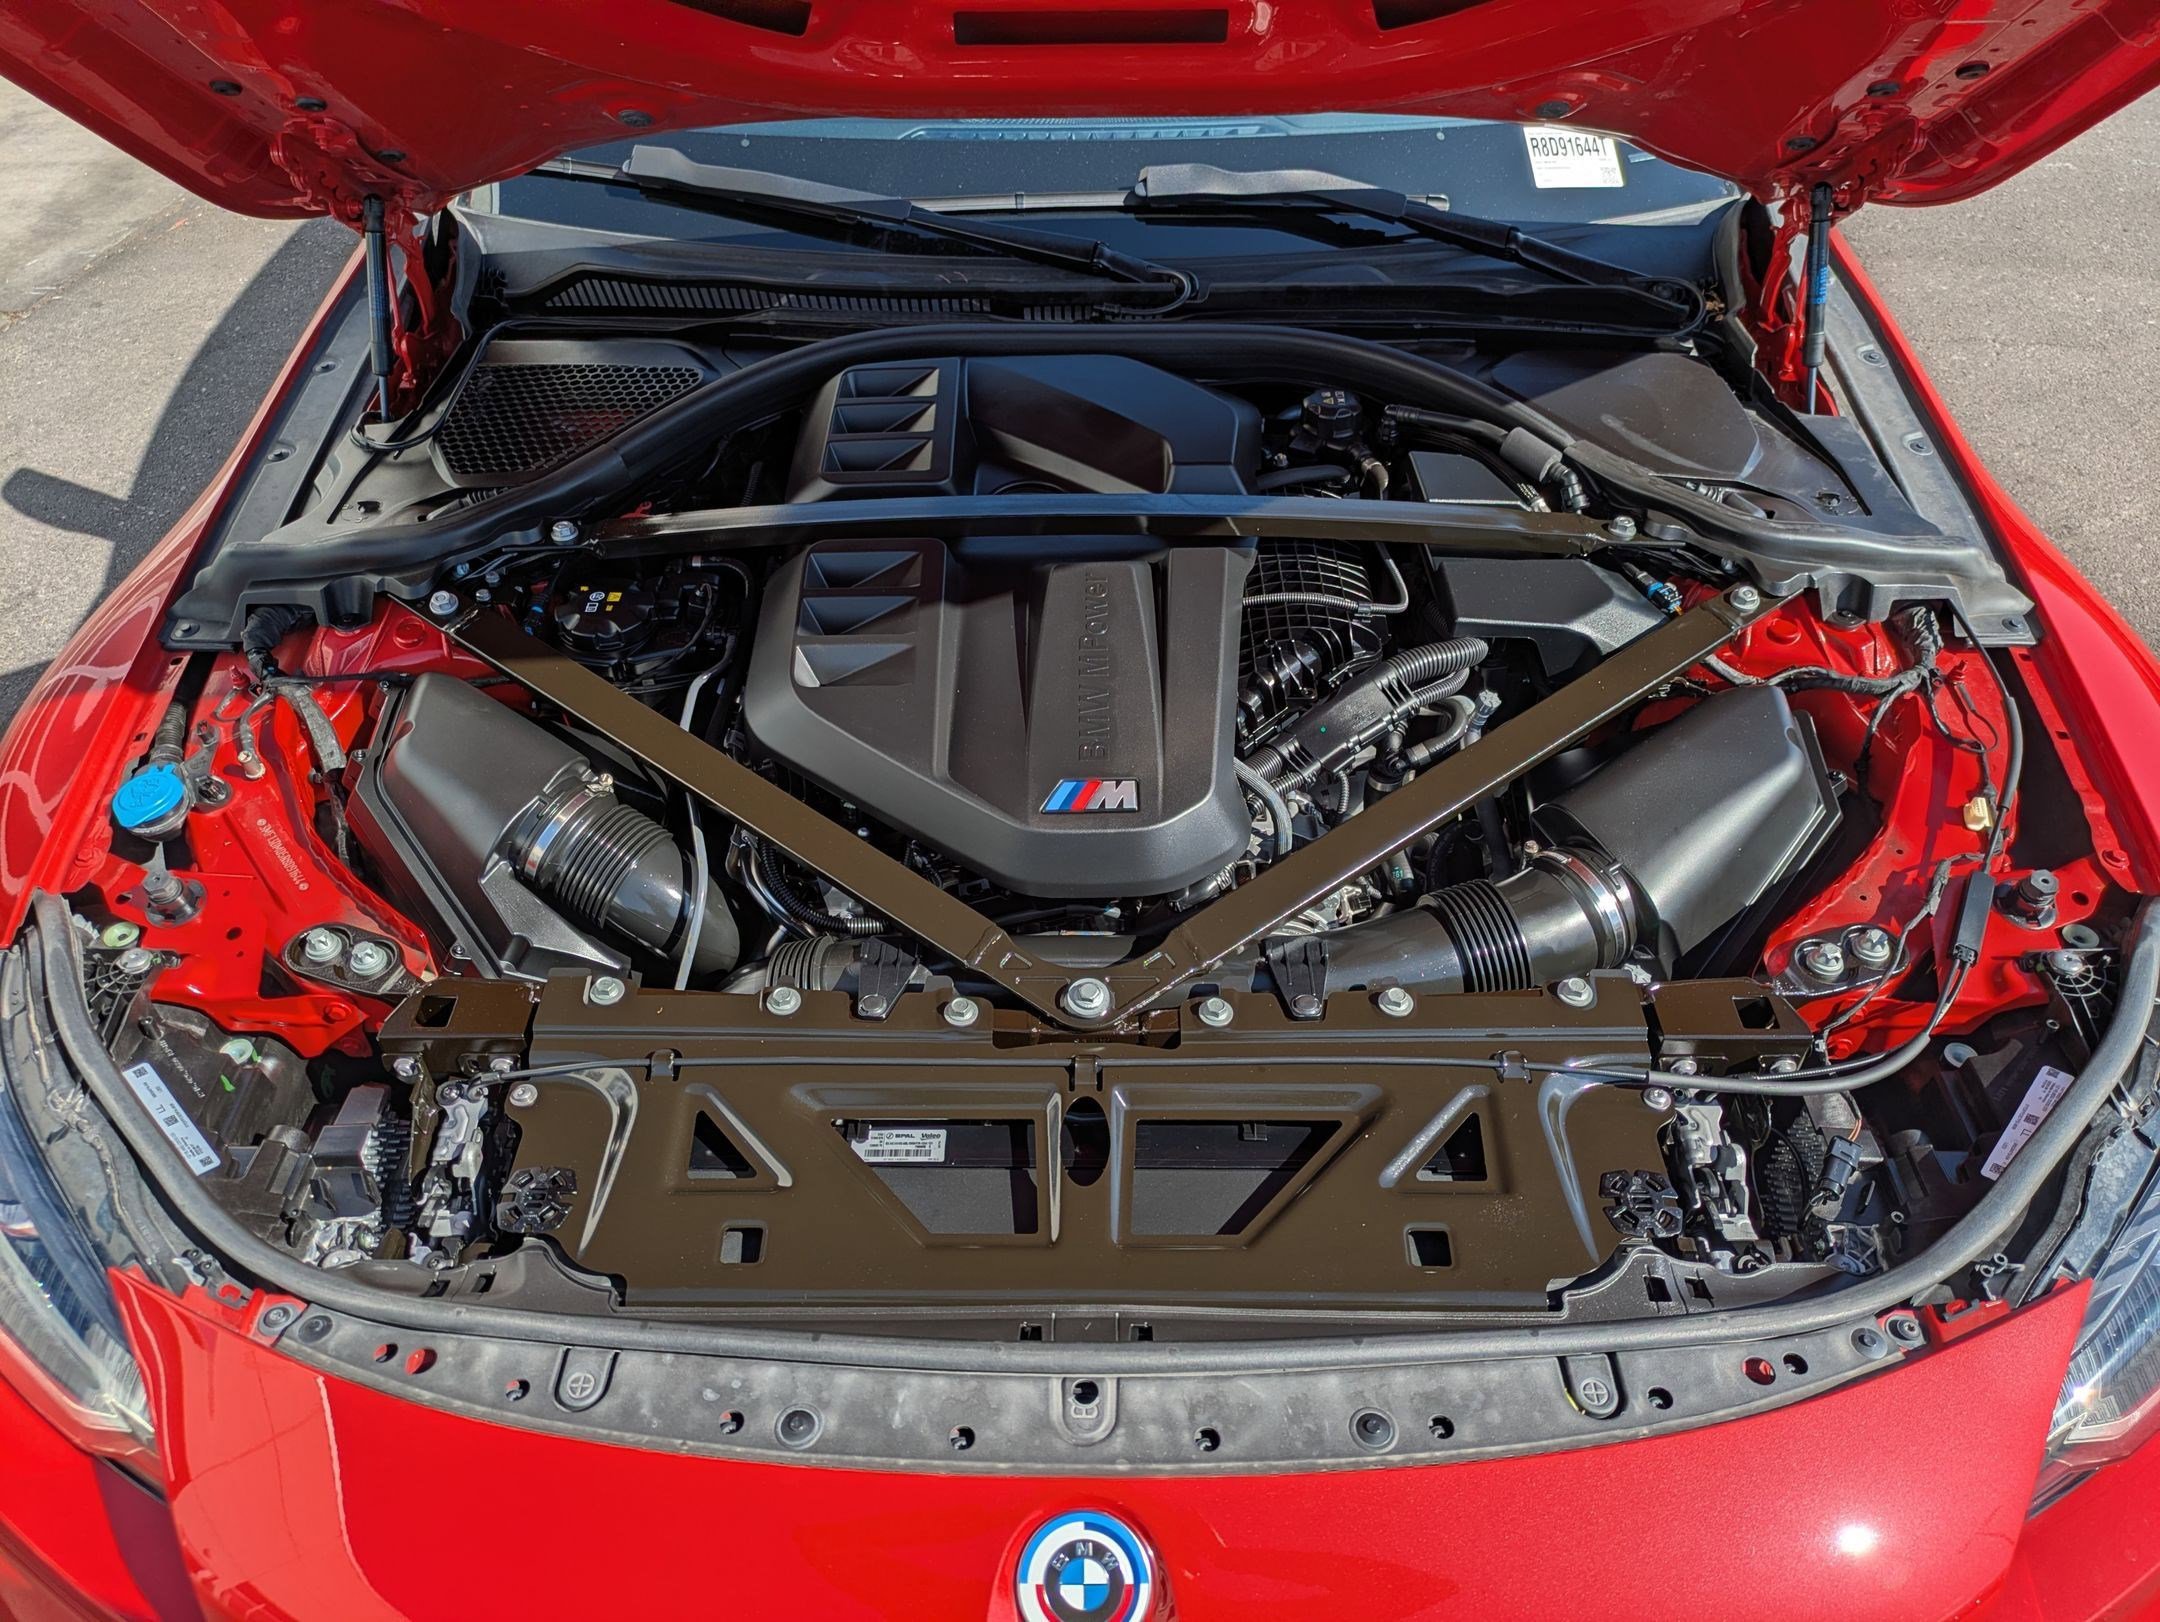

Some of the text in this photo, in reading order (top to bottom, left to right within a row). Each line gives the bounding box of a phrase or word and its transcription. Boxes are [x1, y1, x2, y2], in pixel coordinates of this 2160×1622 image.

[1079, 684, 1110, 761] BMW
[920, 1132, 941, 1140] Valeo
[1051, 1542, 1119, 1571] BMW
